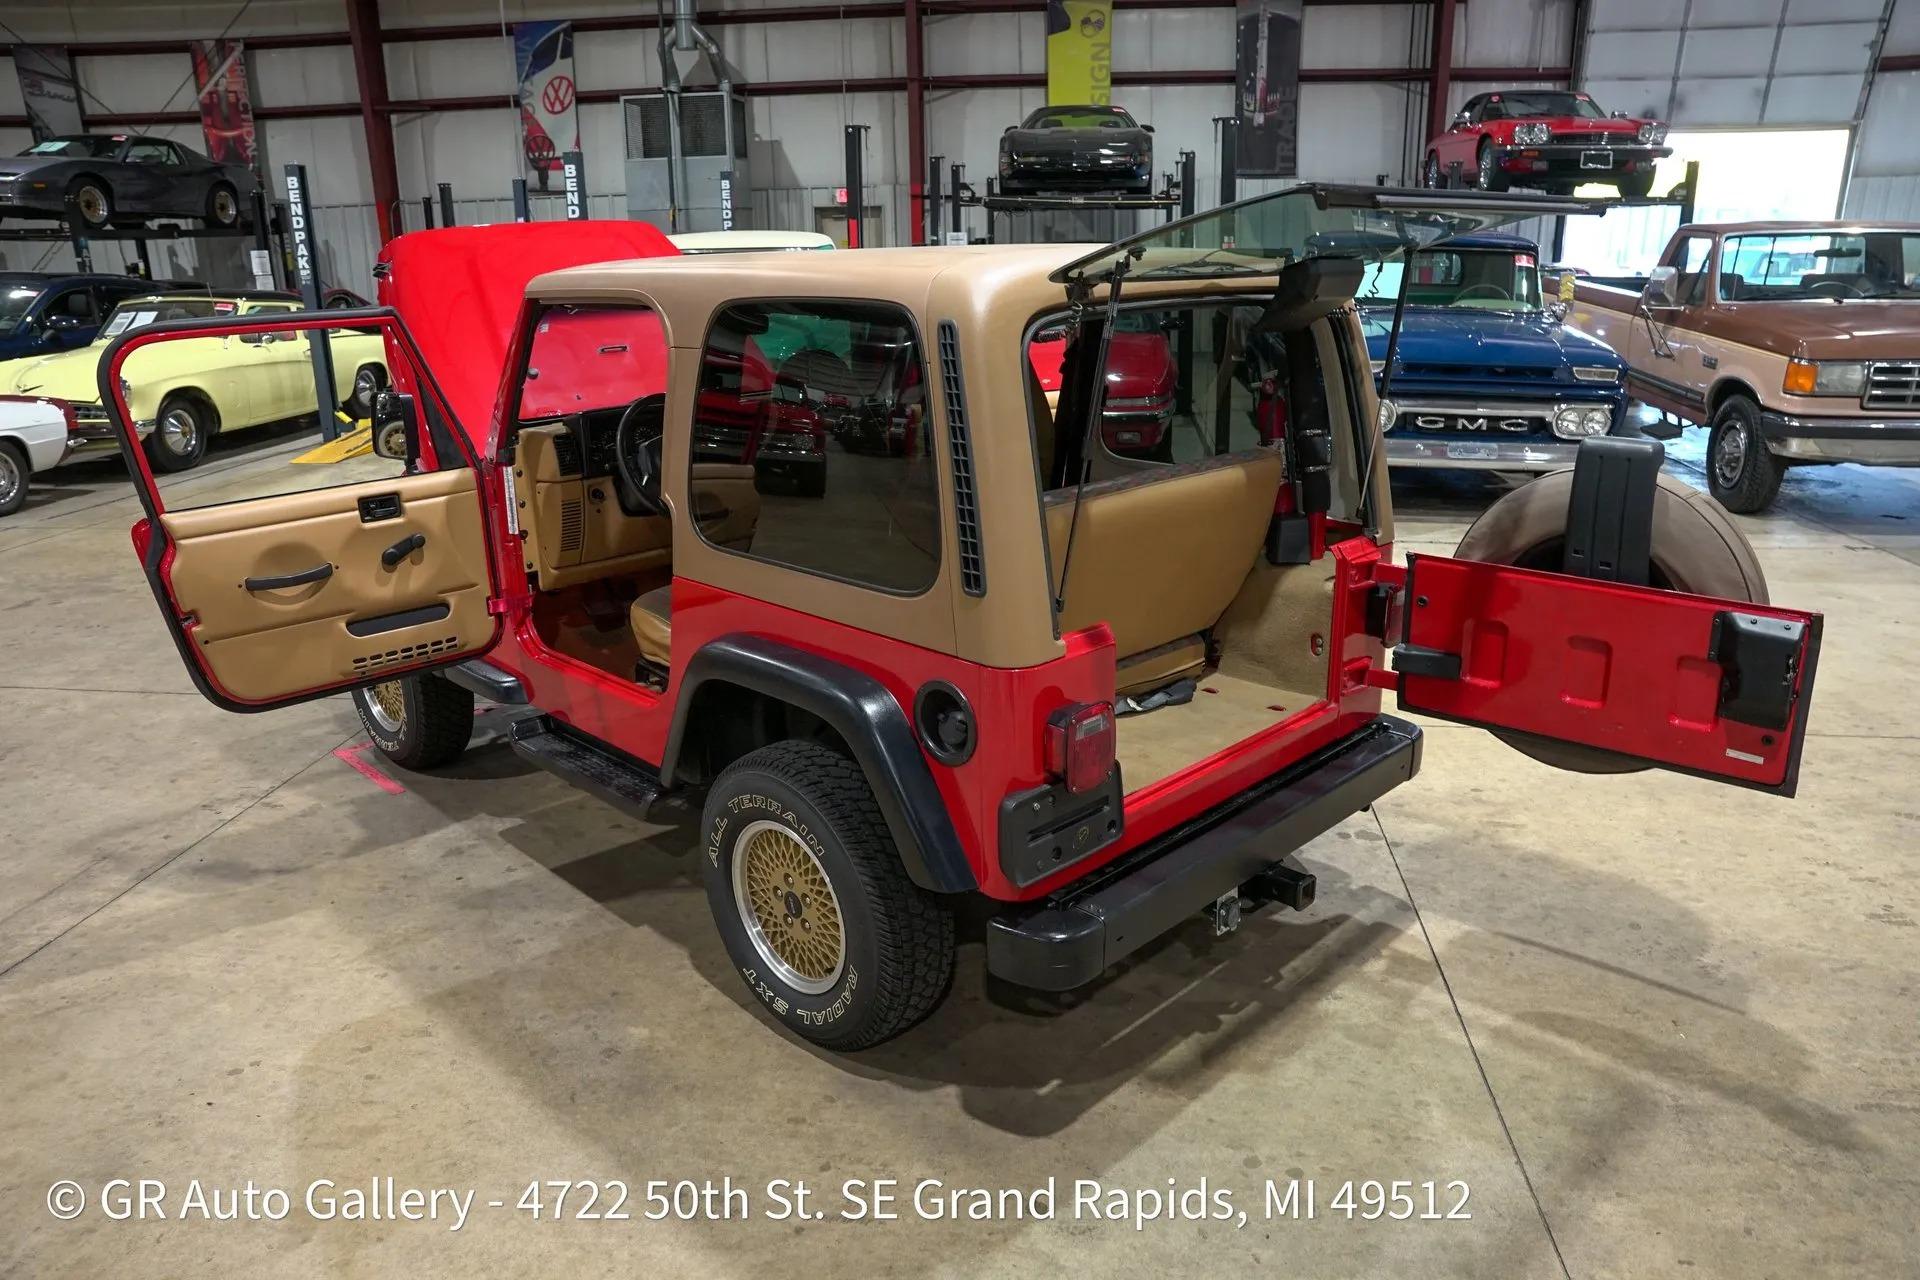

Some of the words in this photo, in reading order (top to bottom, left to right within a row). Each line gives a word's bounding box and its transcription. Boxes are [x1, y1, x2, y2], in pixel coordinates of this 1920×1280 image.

[564, 164, 580, 219] BEND
[721, 180, 732, 230] BENDP
[286, 176, 310, 269] BENDPAK
[1416, 416, 1528, 432] GMC
[708, 816, 728, 868] ALL
[728, 794, 825, 857] TERRAIN
[743, 967, 789, 1016] SXT
[796, 964, 859, 1026] RADIAL
